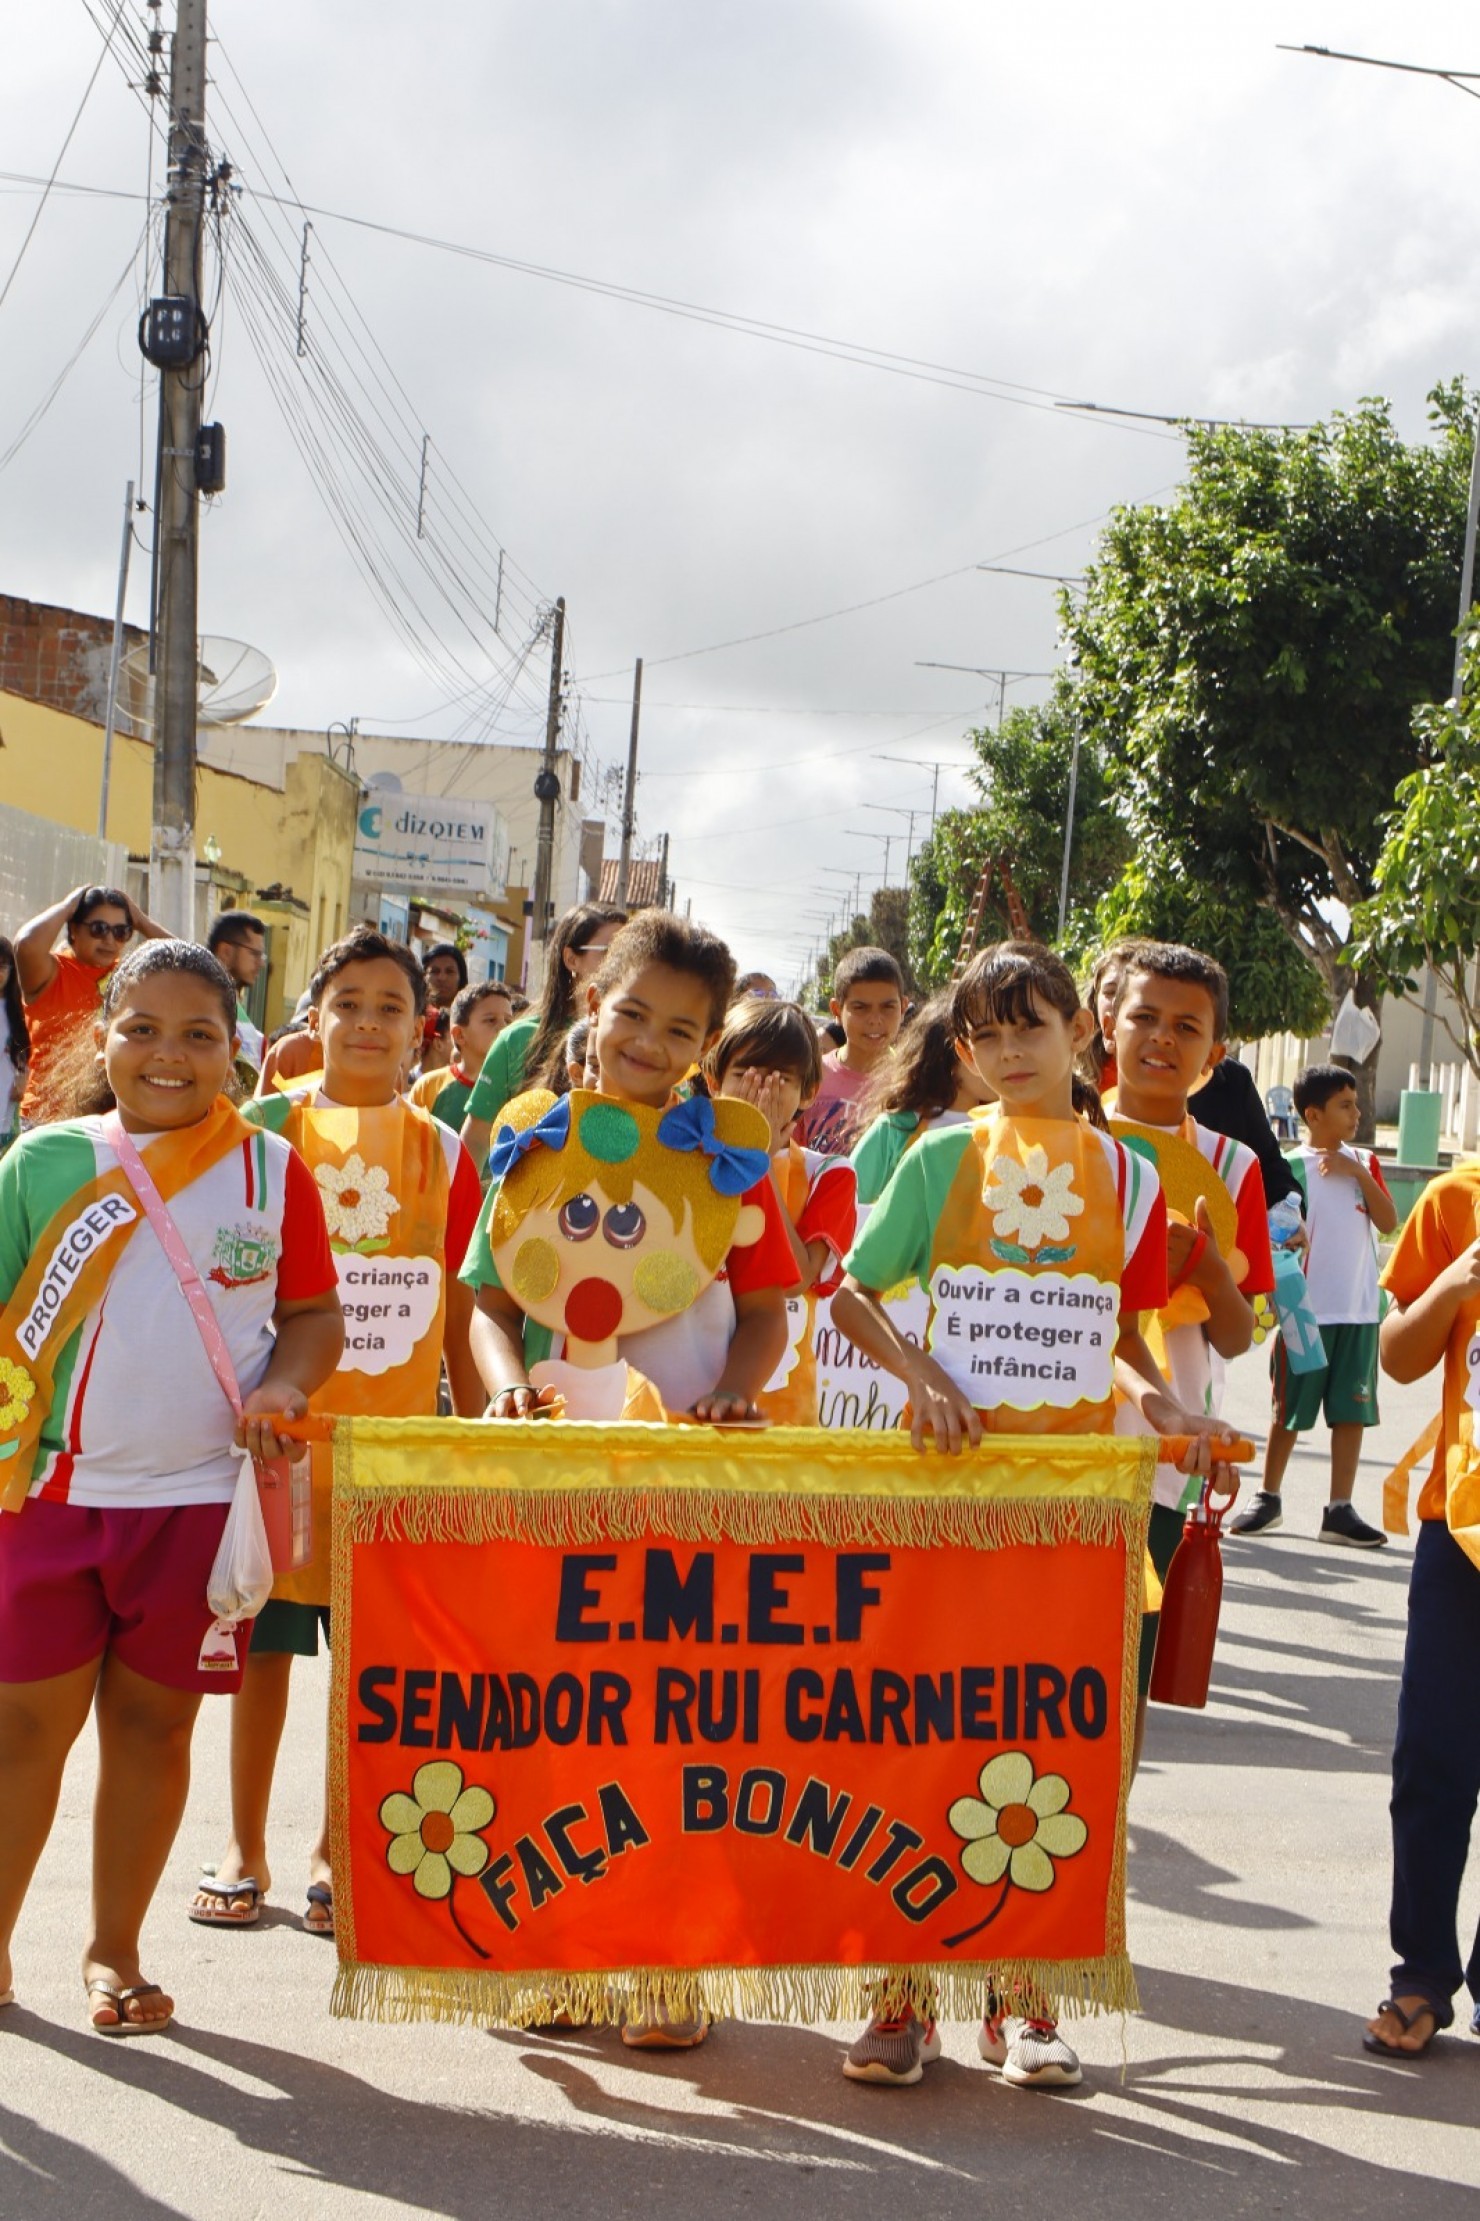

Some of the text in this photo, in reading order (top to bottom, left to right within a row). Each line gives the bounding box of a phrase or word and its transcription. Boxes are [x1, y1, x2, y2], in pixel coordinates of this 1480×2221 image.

[23, 1198, 131, 1350] PROTEGER
[345, 1268, 429, 1289] criança
[398, 1303, 411, 1317] a
[938, 1279, 1113, 1315] Ouvir a criança
[947, 1311, 1102, 1347] É proteger a
[970, 1355, 1077, 1381] infância
[555, 1548, 891, 1644] E.M.E.F
[358, 1663, 1108, 1752] SENADOR RUI CARNEIRO
[478, 1763, 958, 1933] FAÇA BONITO
